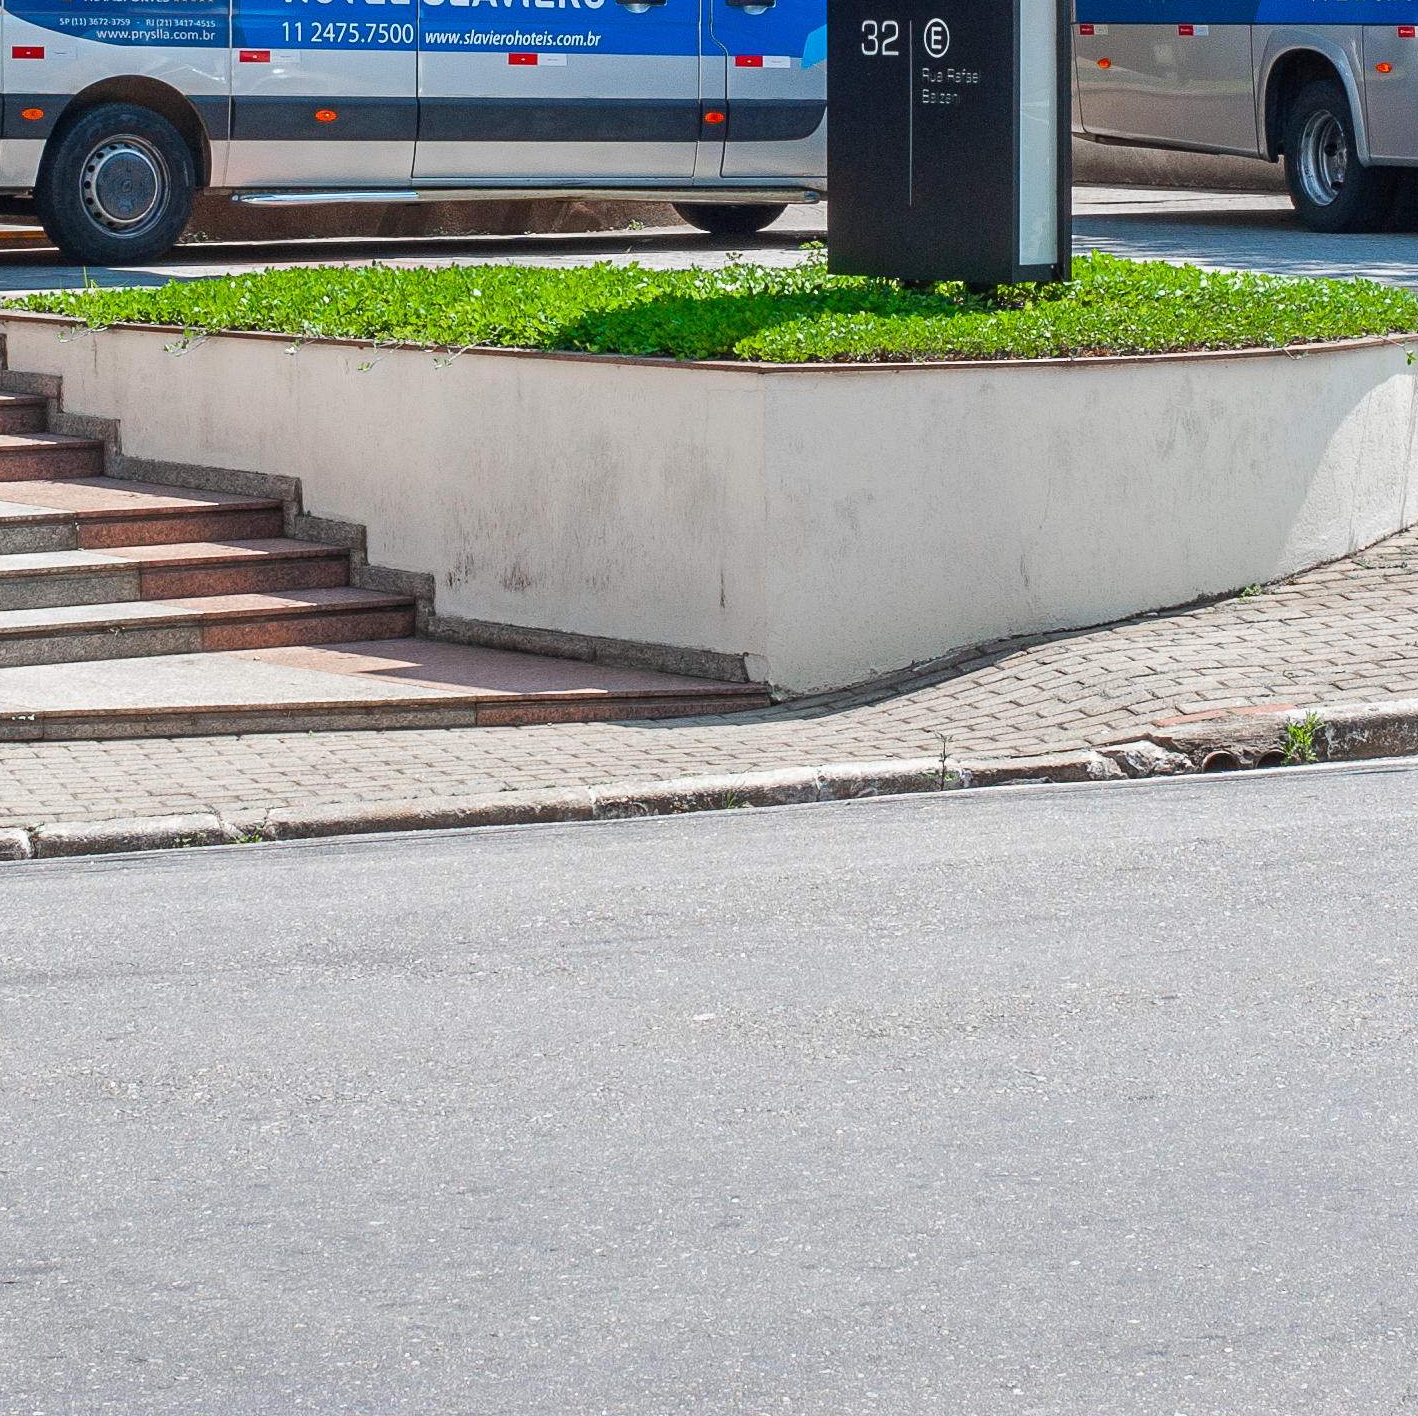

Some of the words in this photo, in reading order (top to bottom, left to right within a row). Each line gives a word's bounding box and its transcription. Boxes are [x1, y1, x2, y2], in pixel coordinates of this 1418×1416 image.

[59, 17, 70, 26] SP
[71, 17, 87, 27] (11)
[88, 17, 131, 26] 3672-3759
[145, 19, 156, 27] RJ
[156, 18, 173, 28] (21)
[174, 19, 216, 28] 3417-4515
[96, 29, 216, 42] www.pryslla.com.br
[282, 21, 303, 43] 11
[310, 21, 414, 45] 2475.7500
[424, 29, 601, 48] www.slavierohoteis.com.br
[861, 20, 899, 55] 32
[922, 67, 943, 83] Rua
[947, 68, 981, 84] Rafael
